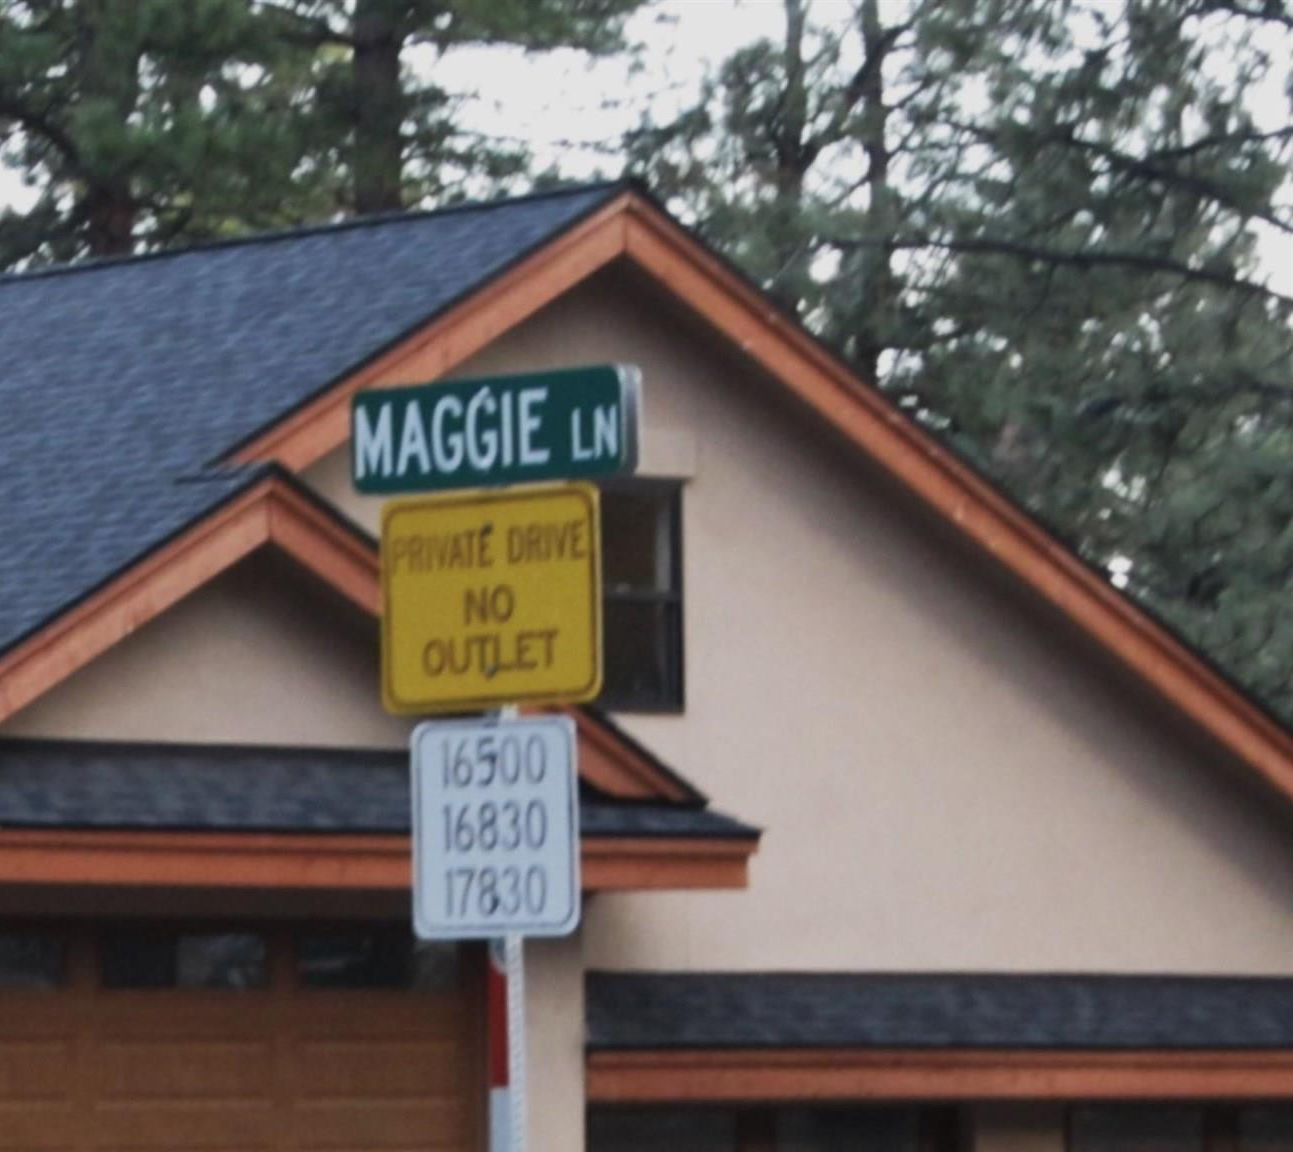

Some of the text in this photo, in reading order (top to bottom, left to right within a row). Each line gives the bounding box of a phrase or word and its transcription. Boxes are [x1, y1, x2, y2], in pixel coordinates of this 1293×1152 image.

[355, 387, 618, 480] MAGGIE LN
[392, 518, 588, 575] PRIVATE DRIVE
[464, 584, 515, 625] NO
[422, 629, 559, 679] OUTLET
[442, 734, 547, 788] 16500
[443, 798, 548, 853] 16830
[445, 864, 547, 918] 17830
